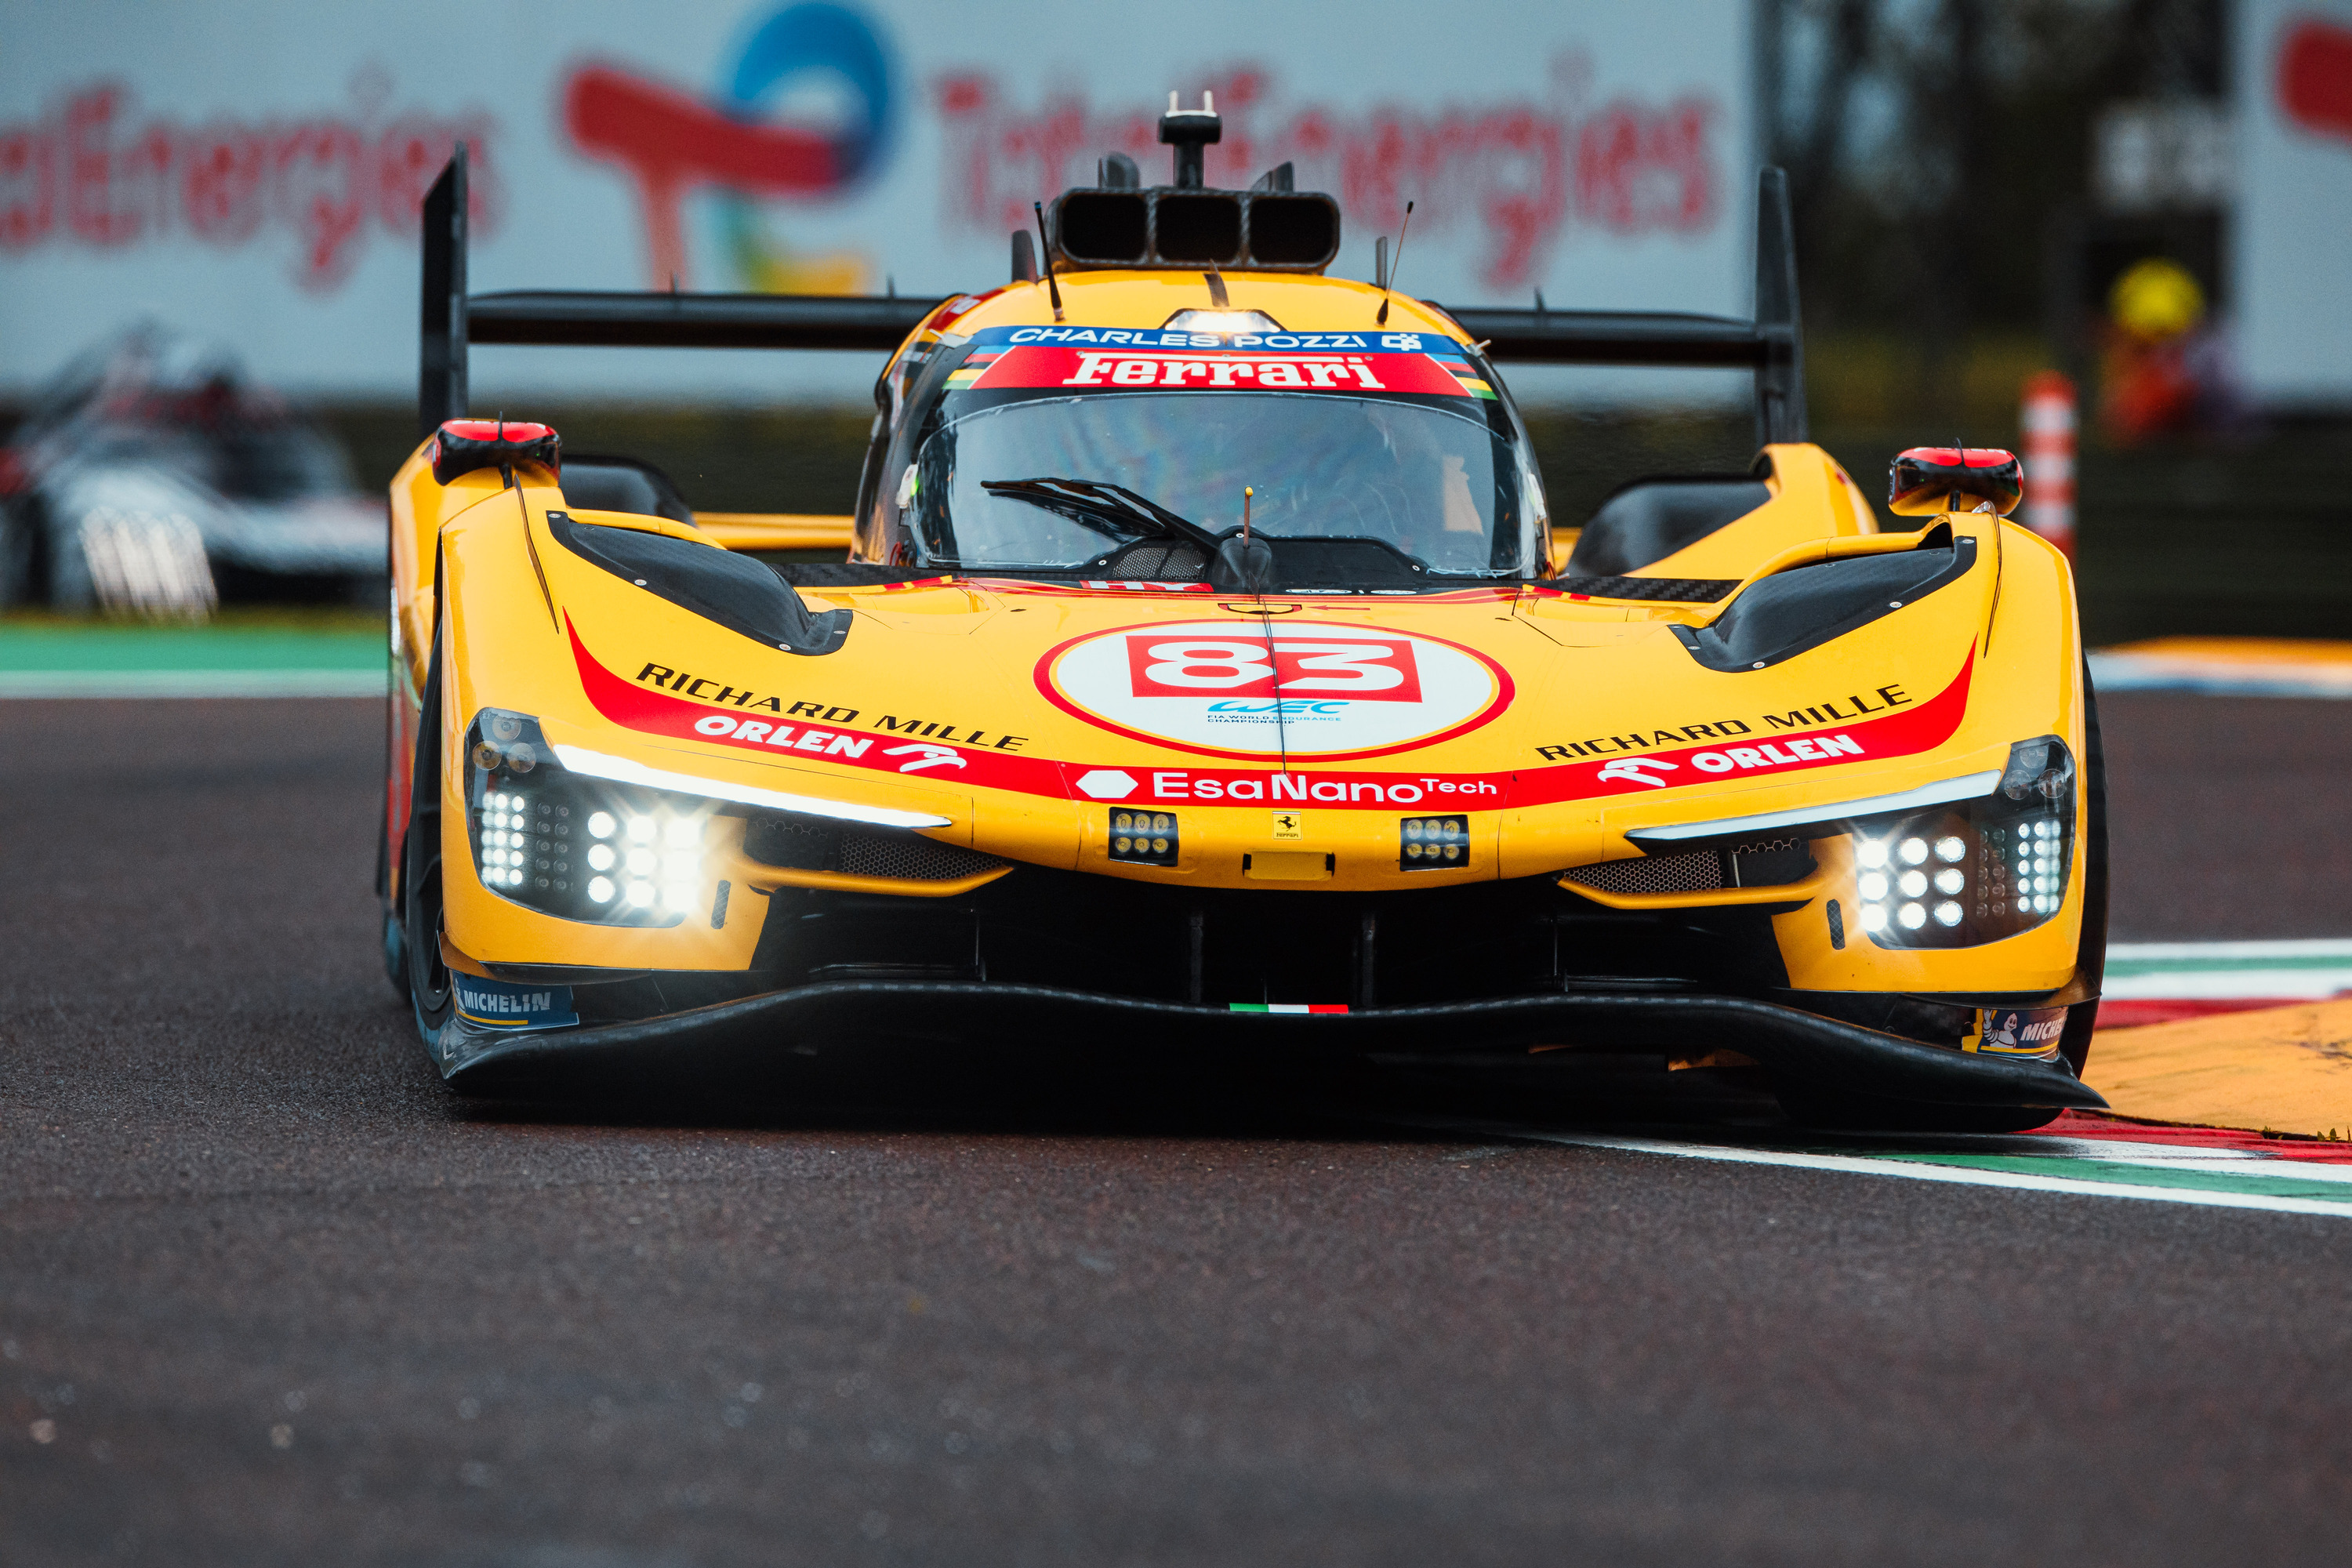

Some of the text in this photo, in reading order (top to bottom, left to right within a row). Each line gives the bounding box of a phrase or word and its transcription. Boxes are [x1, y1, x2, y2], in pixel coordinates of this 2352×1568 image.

[1009, 328, 1220, 347] CHARLES
[1234, 335, 1367, 348] POZZI
[1062, 352, 1386, 389] Ferrari
[1145, 641, 1404, 691] 83
[636, 662, 1029, 751] RICHARD MILLE
[1207, 700, 1350, 714] WEC
[1535, 684, 1913, 761] RICHARD MILLE
[695, 715, 874, 758] ORLEN
[1691, 734, 1865, 773] ORLEN
[1153, 771, 1497, 804] EsaNanoTech
[463, 989, 551, 1013] MICHELIN
[2020, 1015, 2065, 1041] MICHE
